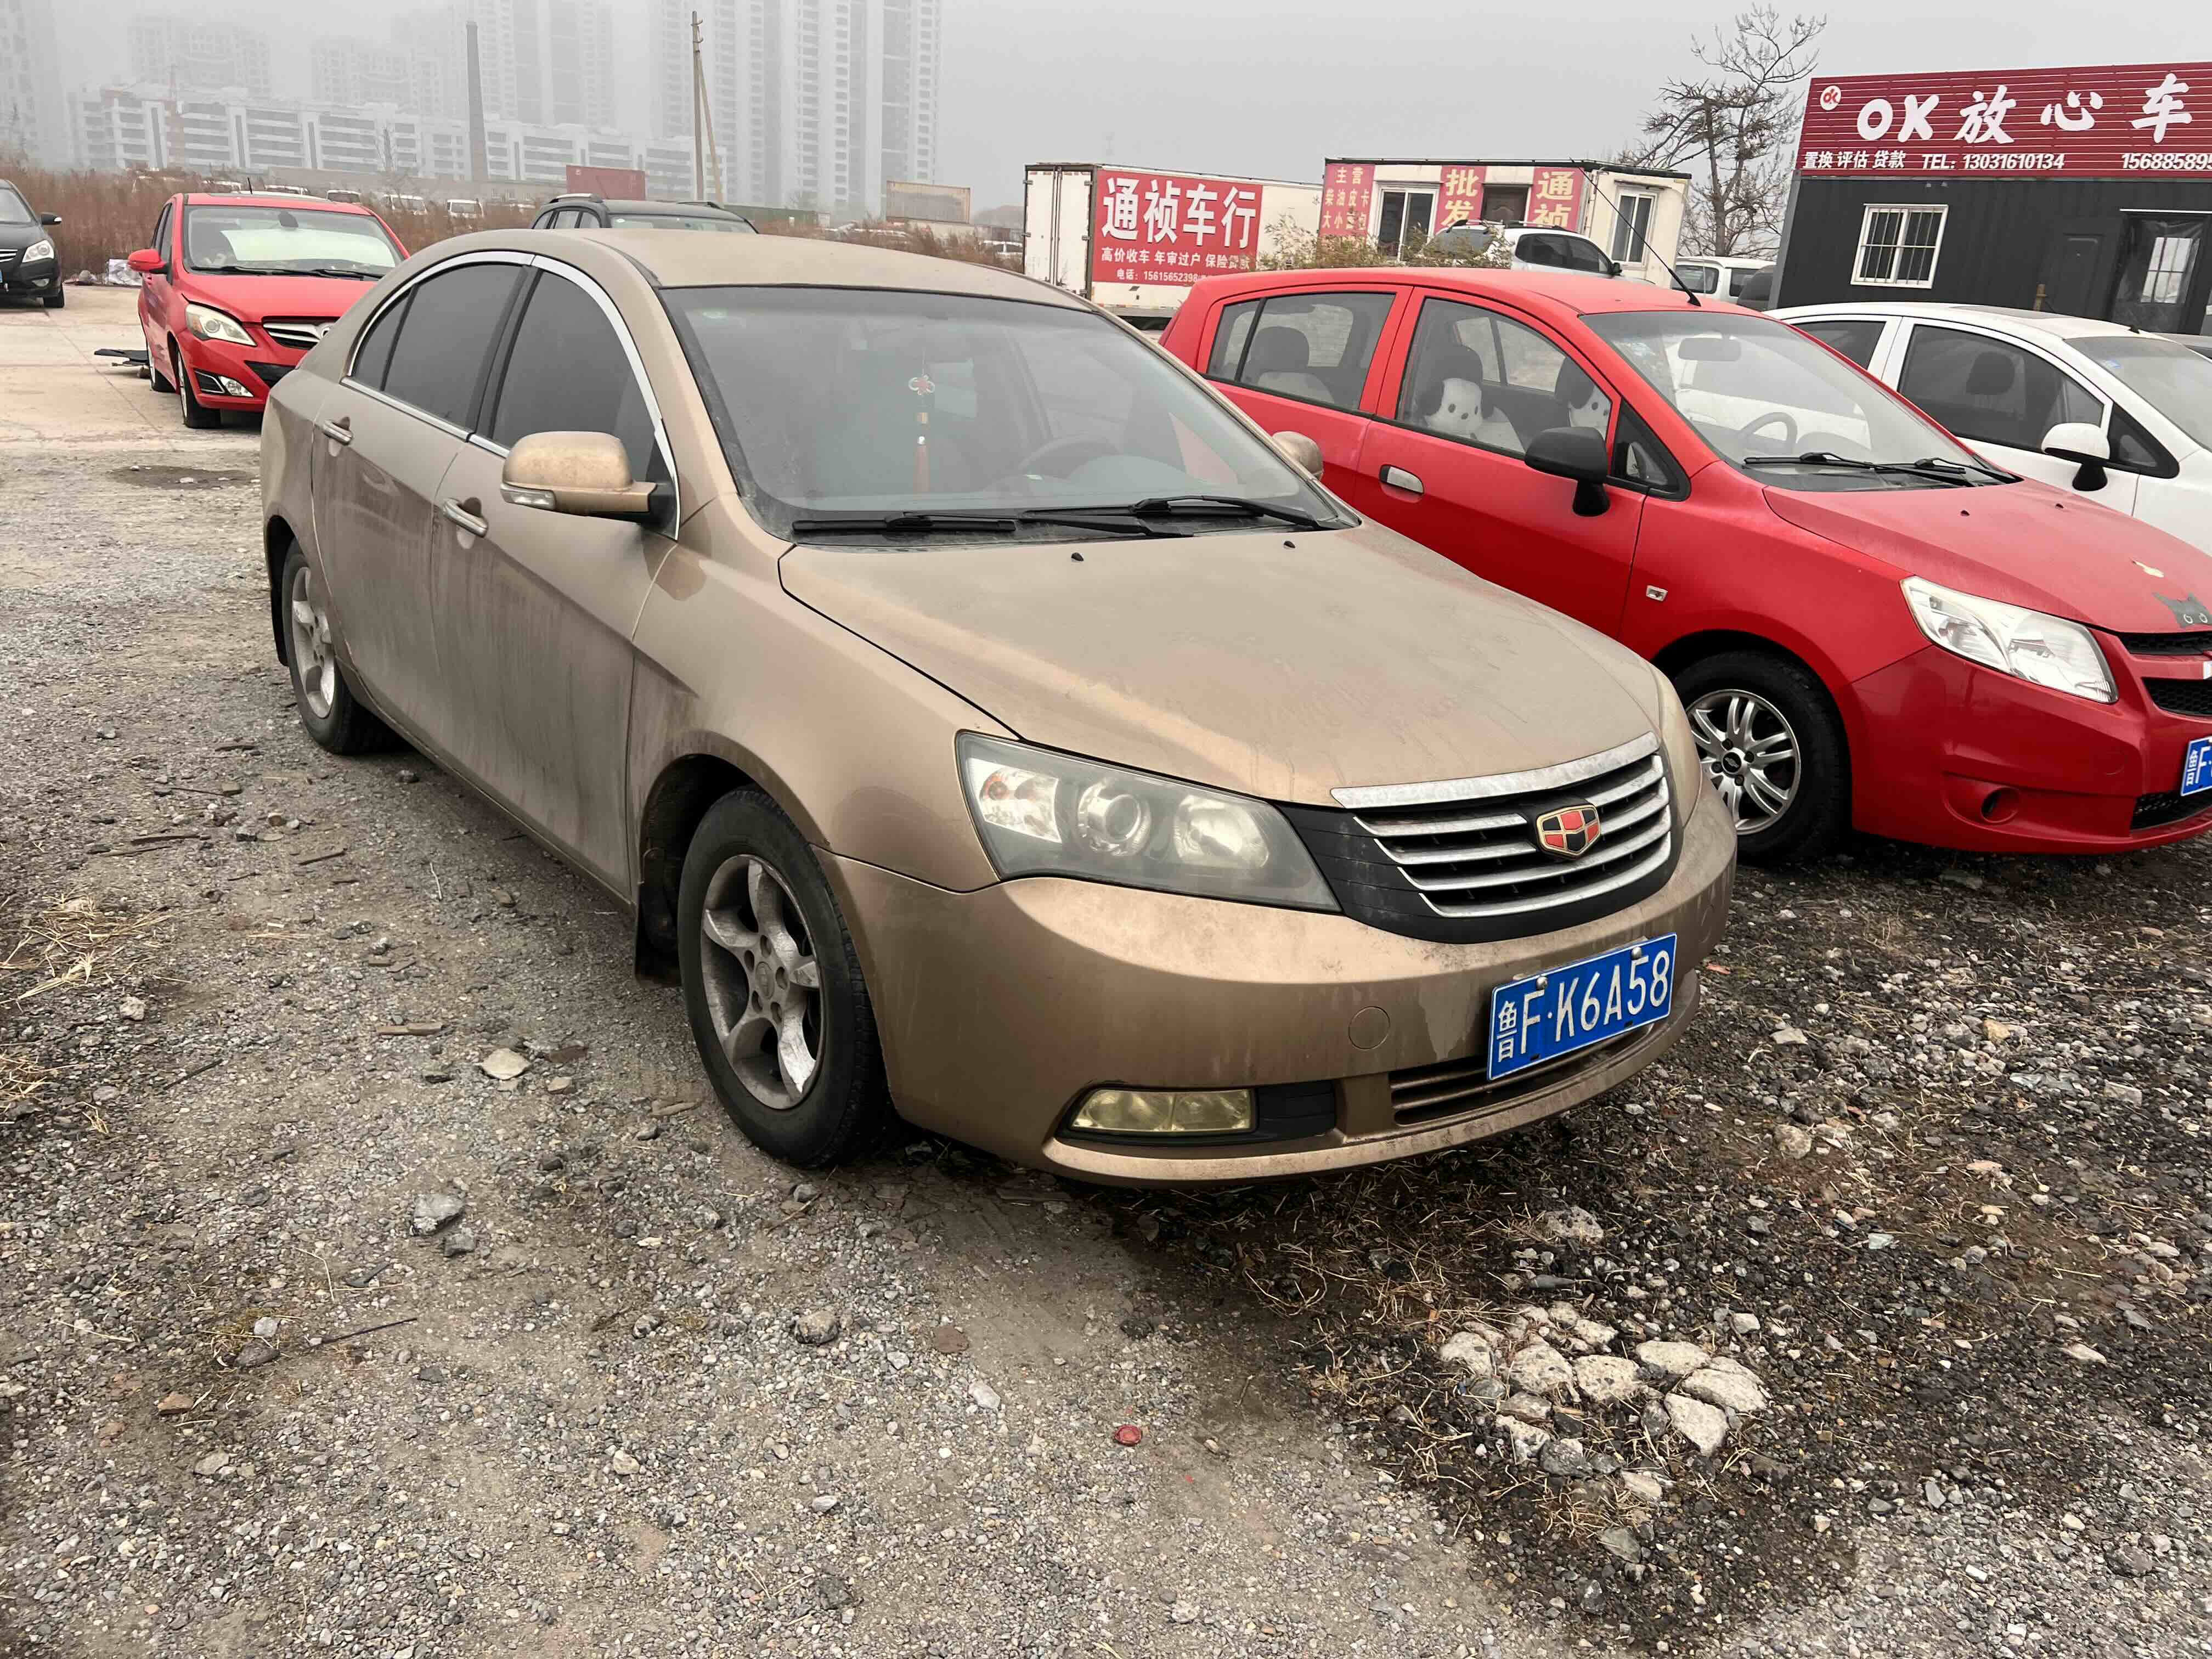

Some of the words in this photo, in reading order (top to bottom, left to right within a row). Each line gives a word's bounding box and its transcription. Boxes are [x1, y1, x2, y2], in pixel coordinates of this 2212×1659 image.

[1857, 94, 1940, 143] OK
[1953, 72, 2192, 144] 放心车
[1803, 151, 1833, 169] 置换
[1837, 151, 1869, 168] 评估
[1872, 150, 1906, 169] 贷款
[1922, 154, 1955, 170] TEL:
[1962, 153, 2065, 170] 13031610134
[1101, 177, 1256, 249] 通祯车行
[1101, 247, 1150, 264] 高价收车
[1154, 251, 1200, 267] 年审过户
[1497, 950, 1669, 1063] 鲁F·K6A58
